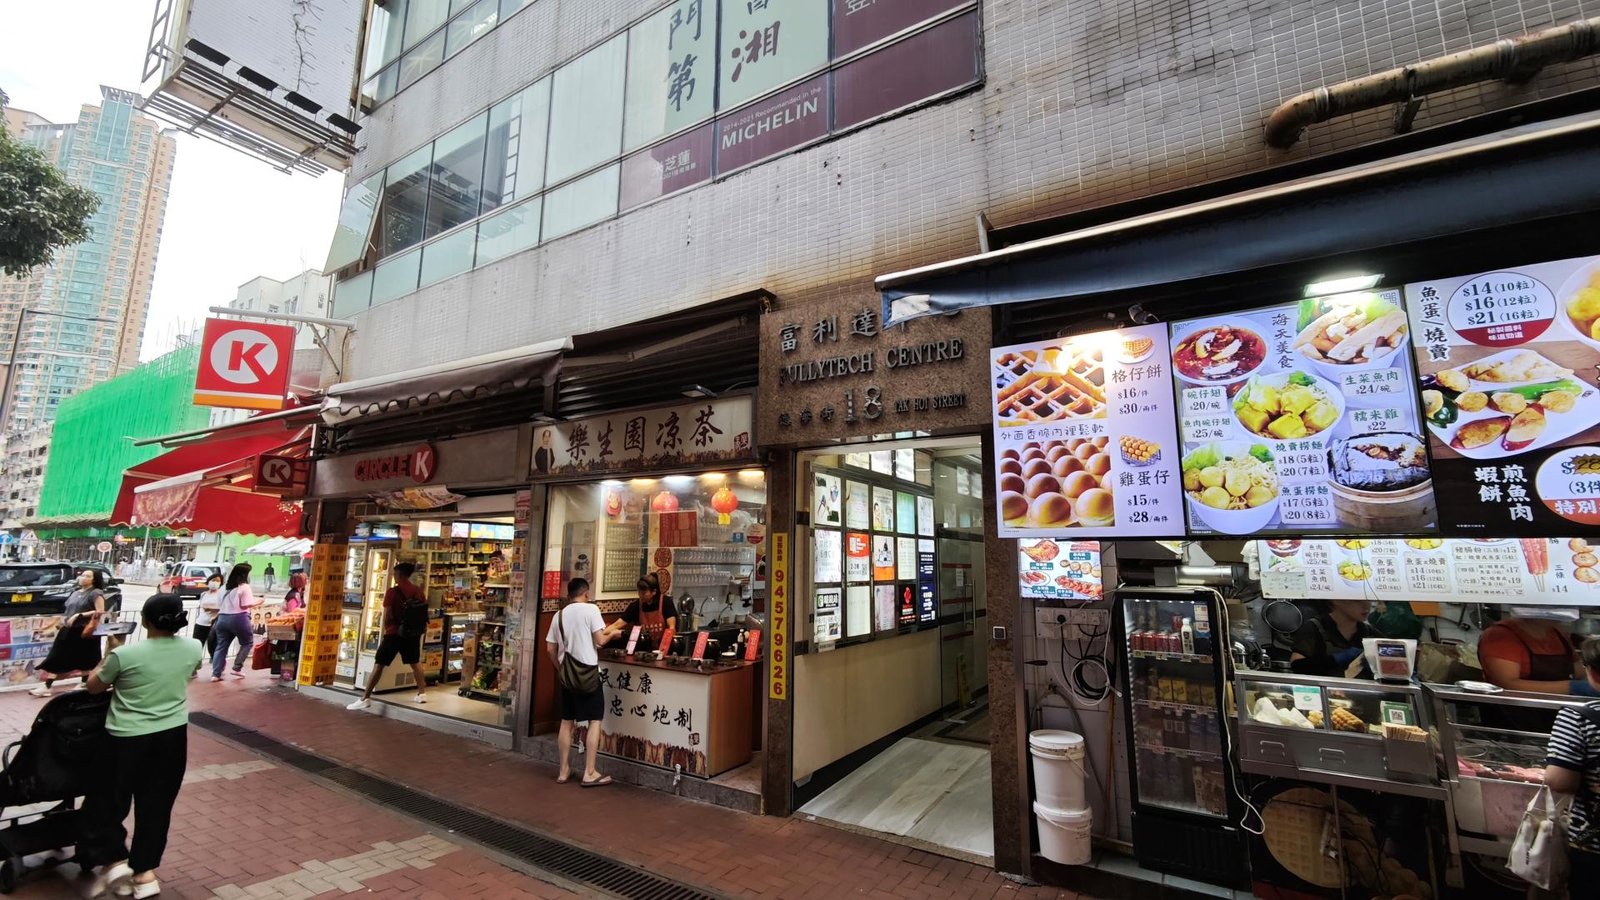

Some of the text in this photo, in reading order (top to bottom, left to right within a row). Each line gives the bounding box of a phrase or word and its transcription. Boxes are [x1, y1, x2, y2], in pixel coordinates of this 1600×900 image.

[668, 0, 702, 111] 門第
[722, 97, 818, 150] MICHELIN
[755, 95, 801, 118] Recommended
[1271, 313, 1294, 368] 海天美食
[228, 340, 271, 382] K
[779, 337, 963, 386] FULLYTECH CENTRE
[1112, 364, 1163, 383] 格仔餅
[1345, 370, 1399, 385] 生菜魚肉
[845, 385, 883, 423] 18
[895, 400, 909, 414] TAK
[932, 393, 967, 410] STREET
[1187, 388, 1221, 399] 碗仔翅
[1184, 417, 1231, 428] 魚肉碗仔翅
[1367, 420, 1387, 431] $22
[269, 463, 288, 481] K
[354, 450, 431, 482] CIRCLE K
[1119, 470, 1171, 488] 雞蛋仔
[1473, 465, 1504, 503] 蝦餅
[1500, 463, 1535, 522] 煎魚肉
[1554, 500, 1600, 515] 特別
[772, 569, 785, 696] 94579626
[609, 694, 693, 732] 忠心炮制
